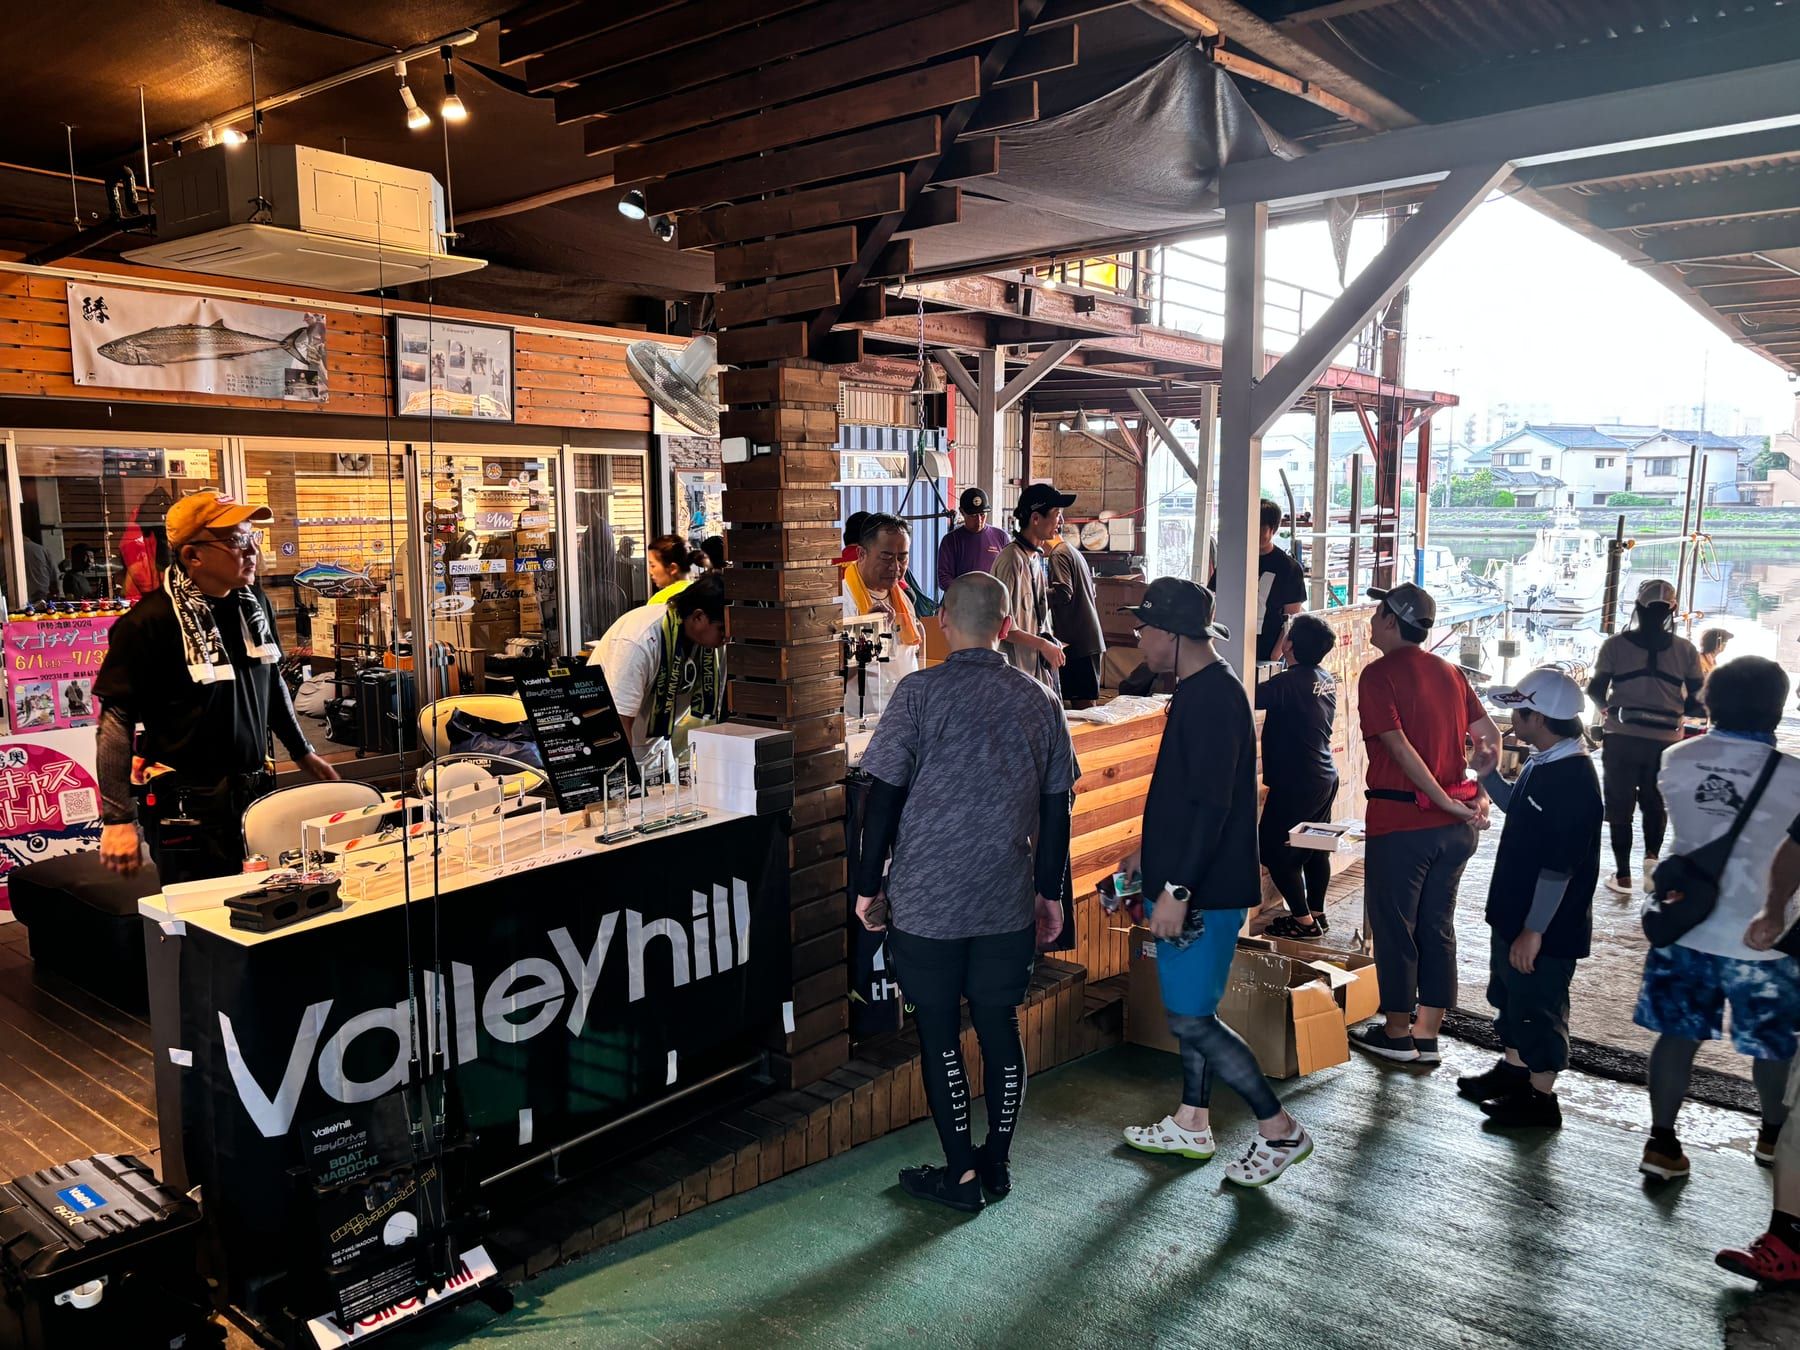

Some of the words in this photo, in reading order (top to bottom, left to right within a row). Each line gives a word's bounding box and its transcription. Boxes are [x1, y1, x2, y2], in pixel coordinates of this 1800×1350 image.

[479, 588, 524, 602] Jackson
[574, 680, 595, 689] BOAT
[218, 877, 750, 1138] Valleyhill
[943, 1049, 968, 1133] ELECTRIC
[999, 1064, 1017, 1133] ELECTRIC
[318, 1155, 380, 1184] MAGOCHI
[329, 1149, 364, 1170] BOAT
